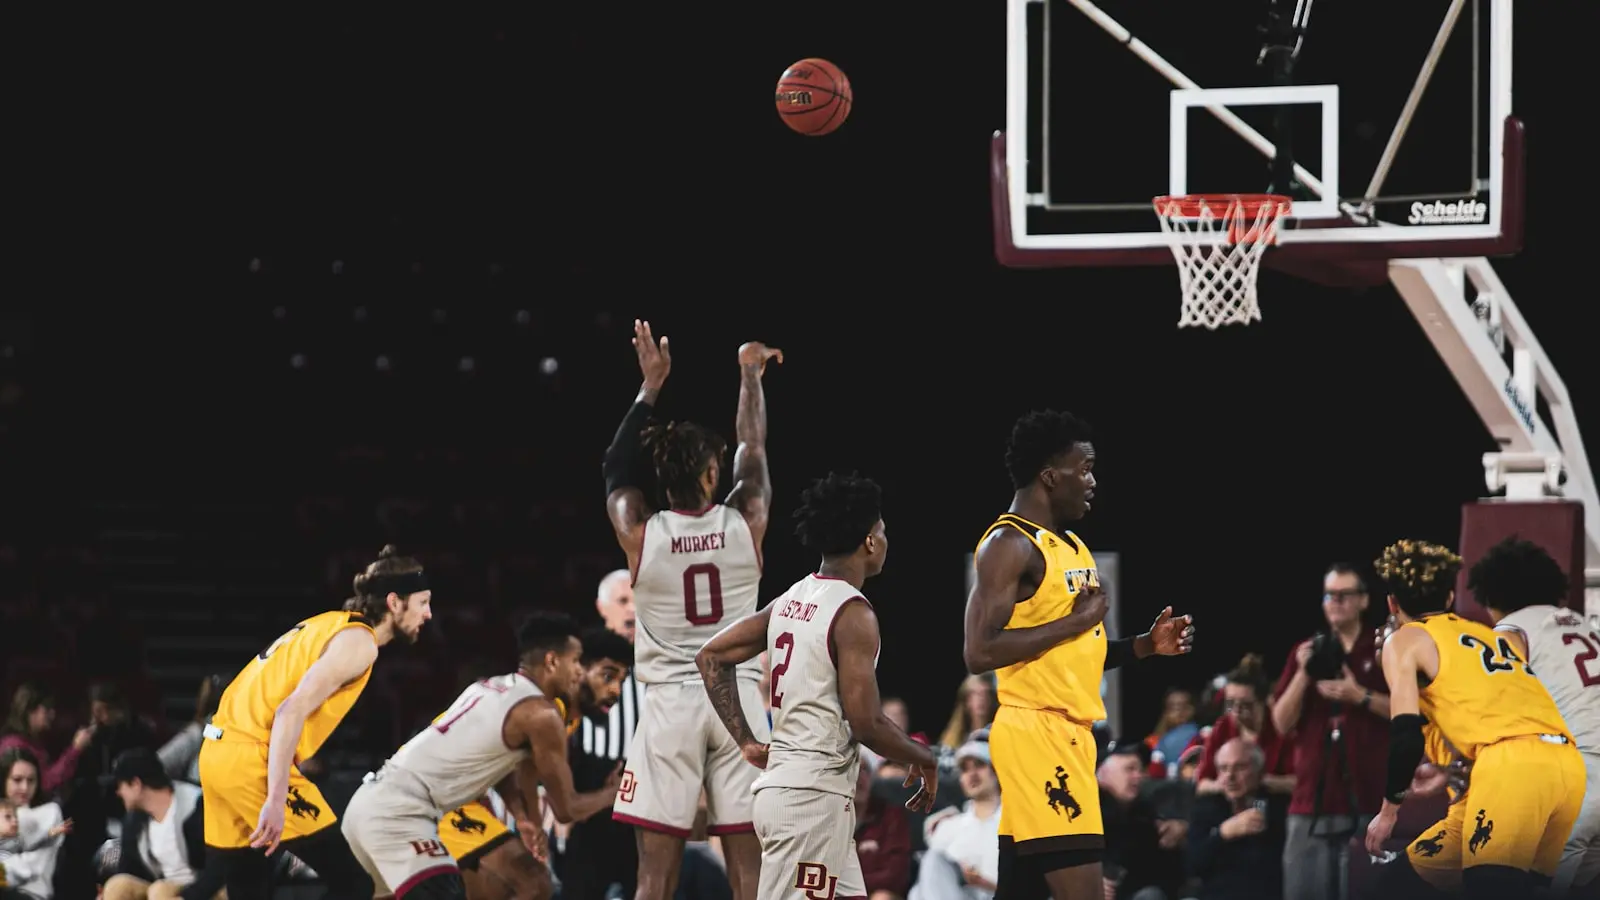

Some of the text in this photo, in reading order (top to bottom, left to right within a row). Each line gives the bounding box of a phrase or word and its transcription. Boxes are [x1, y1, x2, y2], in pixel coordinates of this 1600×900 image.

[671, 532, 725, 553] MURKEY
[683, 562, 724, 627] 0
[772, 632, 794, 709] 2
[794, 862, 838, 900] DU
